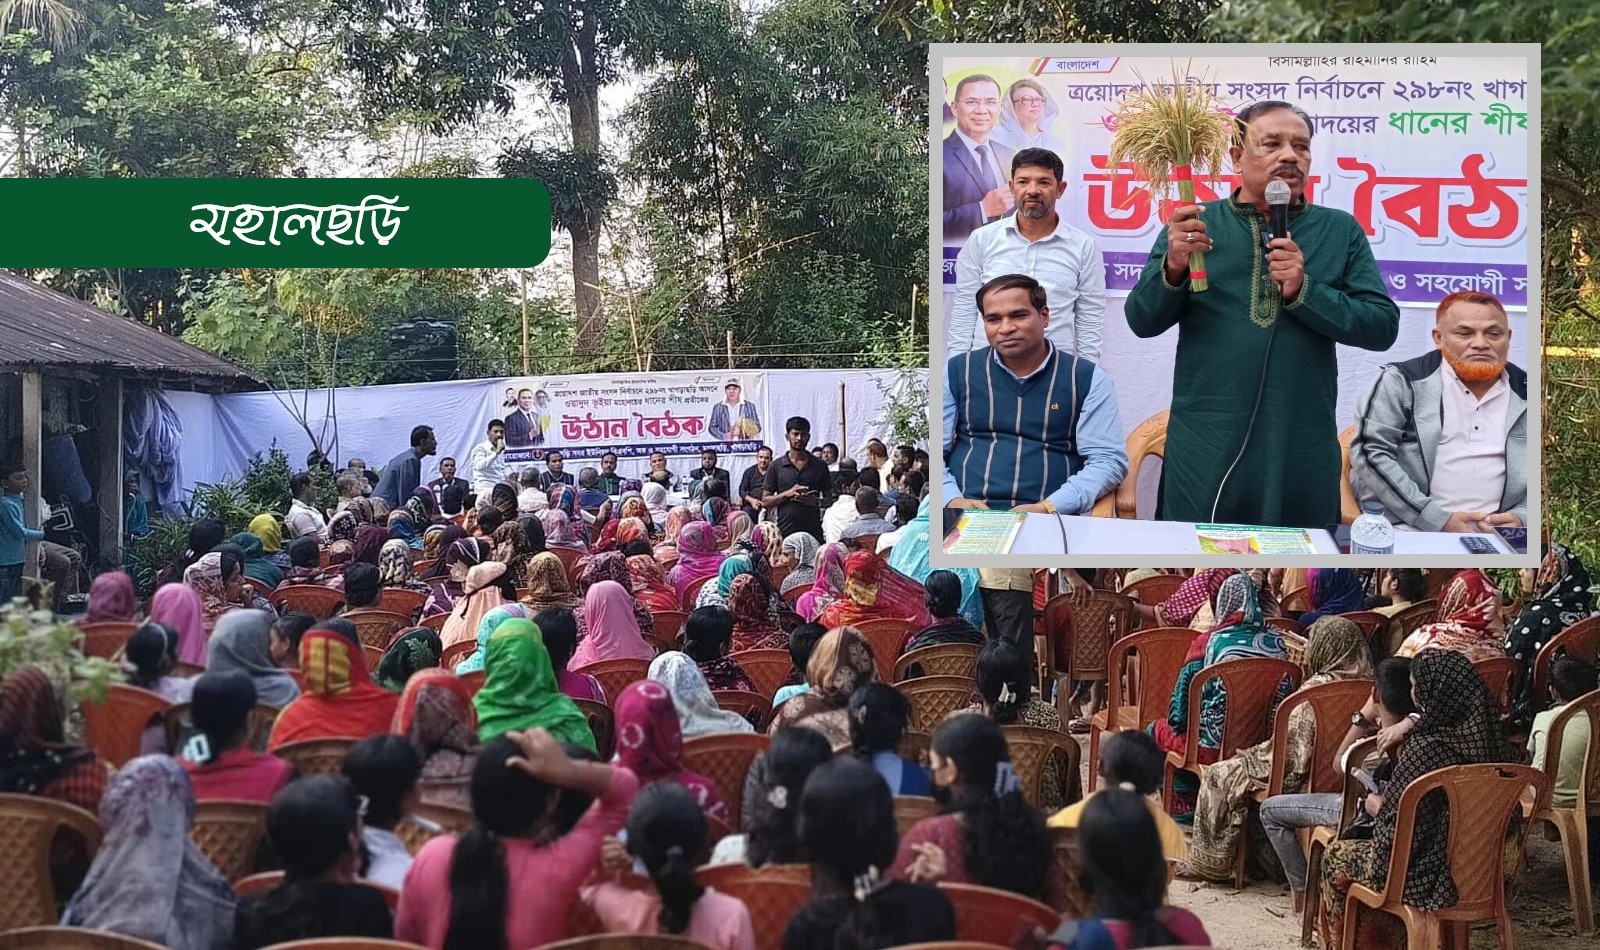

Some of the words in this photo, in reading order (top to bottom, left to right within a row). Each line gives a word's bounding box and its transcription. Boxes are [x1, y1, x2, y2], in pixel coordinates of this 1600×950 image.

[1056, 59, 1100, 71] বাংলাদেশ
[1228, 82, 1290, 101] সংসদ
[1295, 75, 1386, 100] নির্বাচনে
[1393, 80, 1475, 101] ২৯৮নং
[1388, 110, 1473, 135] ধানের
[1336, 153, 1527, 240] বৈঠ
[1389, 273, 1407, 290] ও
[1413, 268, 1508, 296] সহযোগী
[560, 412, 629, 440] উঠান
[632, 410, 705, 437] বৈঠক
